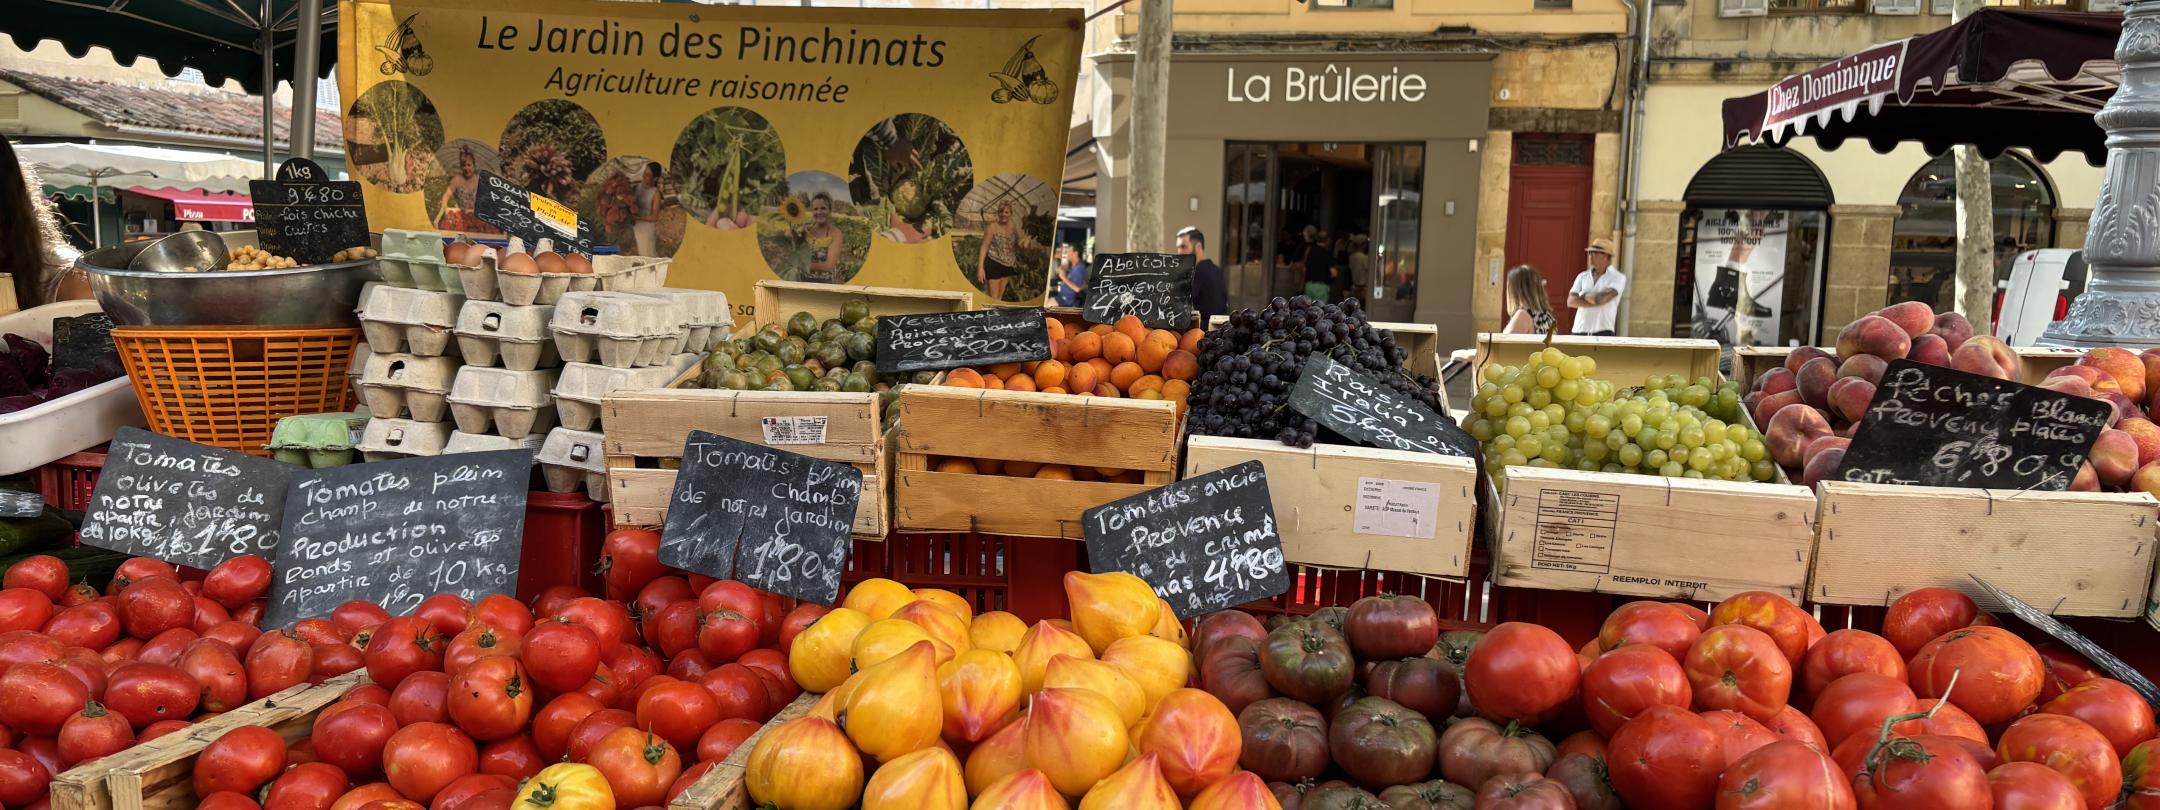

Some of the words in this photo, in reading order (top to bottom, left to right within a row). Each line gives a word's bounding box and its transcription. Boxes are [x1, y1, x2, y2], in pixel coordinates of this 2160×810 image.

[478, 16, 518, 51] Le
[529, 19, 644, 57] Jardin
[659, 22, 723, 60] des
[738, 26, 946, 68] Pinchinats
[544, 66, 700, 96] Agriculture
[708, 75, 849, 104] raisonnée
[1227, 67, 1270, 102] La
[1285, 63, 1427, 102] Brûlerie
[1771, 84, 1800, 115] Chez
[1802, 55, 1896, 105] Dominique
[285, 162, 312, 179] 1kg
[121, 442, 241, 477] Tomates
[299, 471, 410, 507] Tomates
[429, 560, 466, 592] 10
[1612, 575, 1661, 585] REEMPLOI
[1664, 580, 1708, 590] INTERDIT
